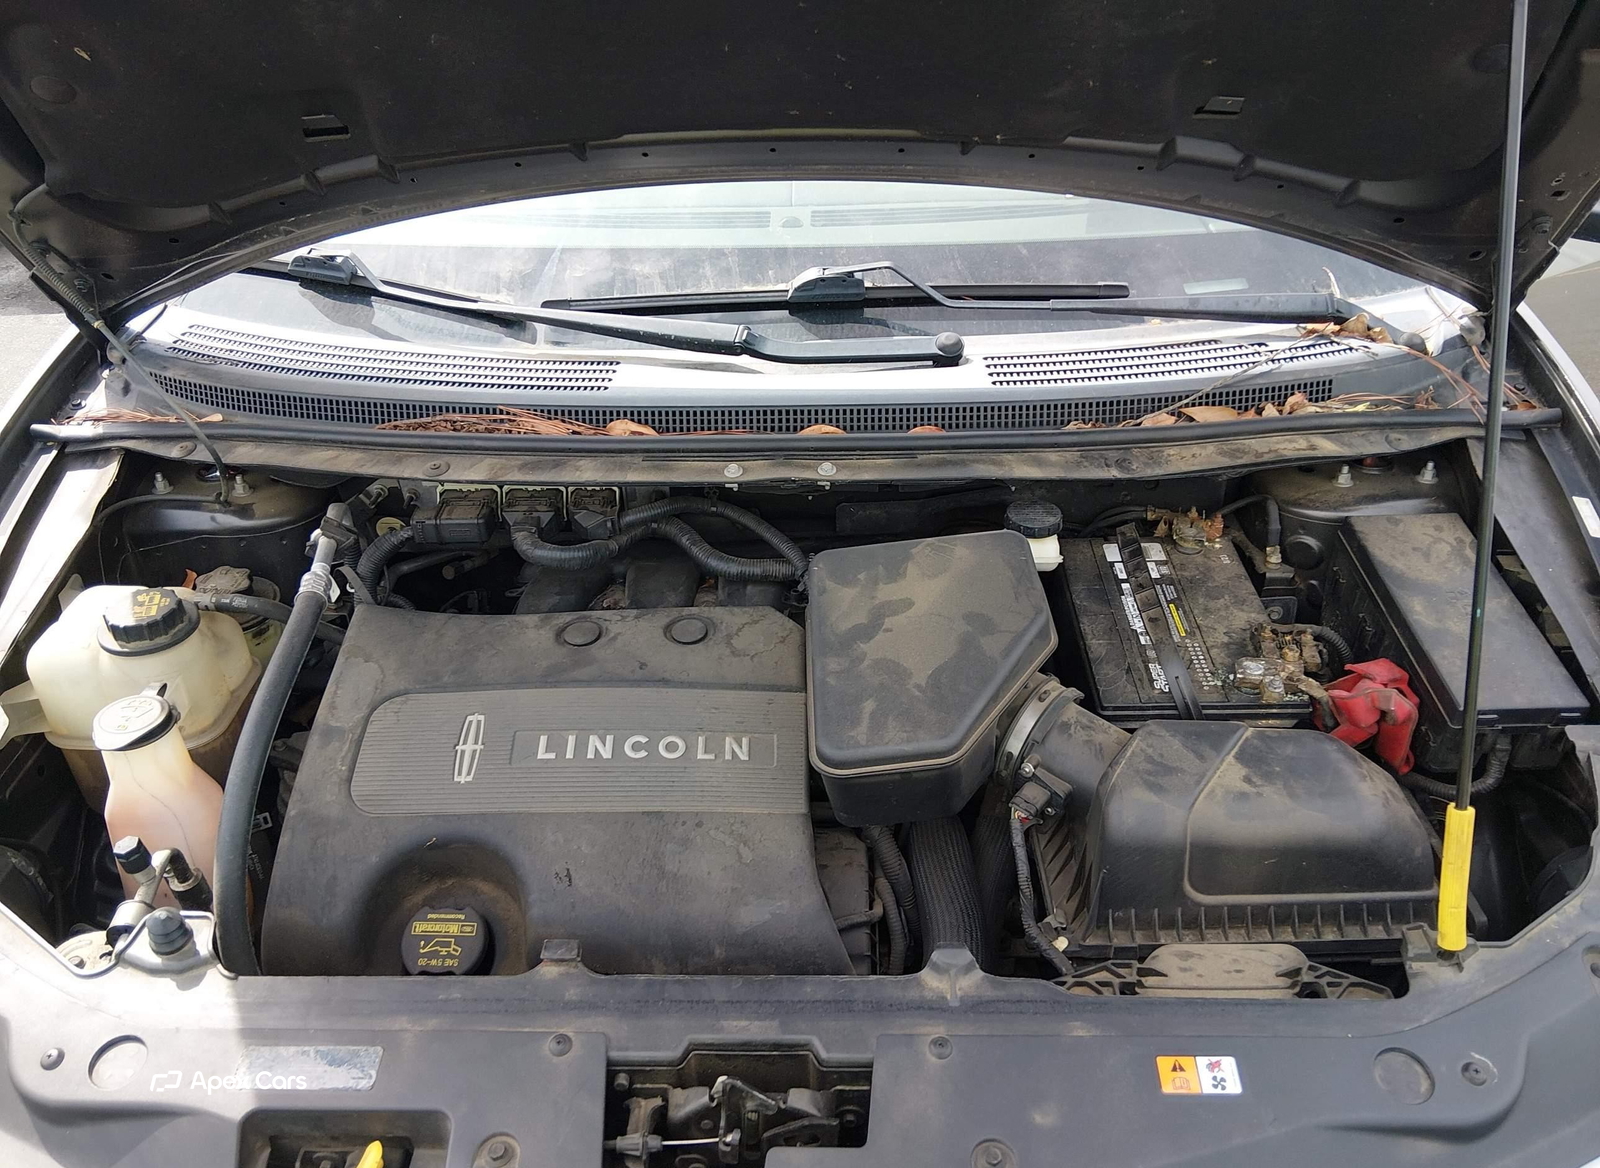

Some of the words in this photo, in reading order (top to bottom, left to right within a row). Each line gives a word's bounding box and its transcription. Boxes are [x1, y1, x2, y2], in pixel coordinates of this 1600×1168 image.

[537, 735, 750, 761] LINCOLN
[415, 923, 458, 933] Motorcraft
[418, 958, 442, 966] 5W-20
[443, 958, 458, 966] SAE
